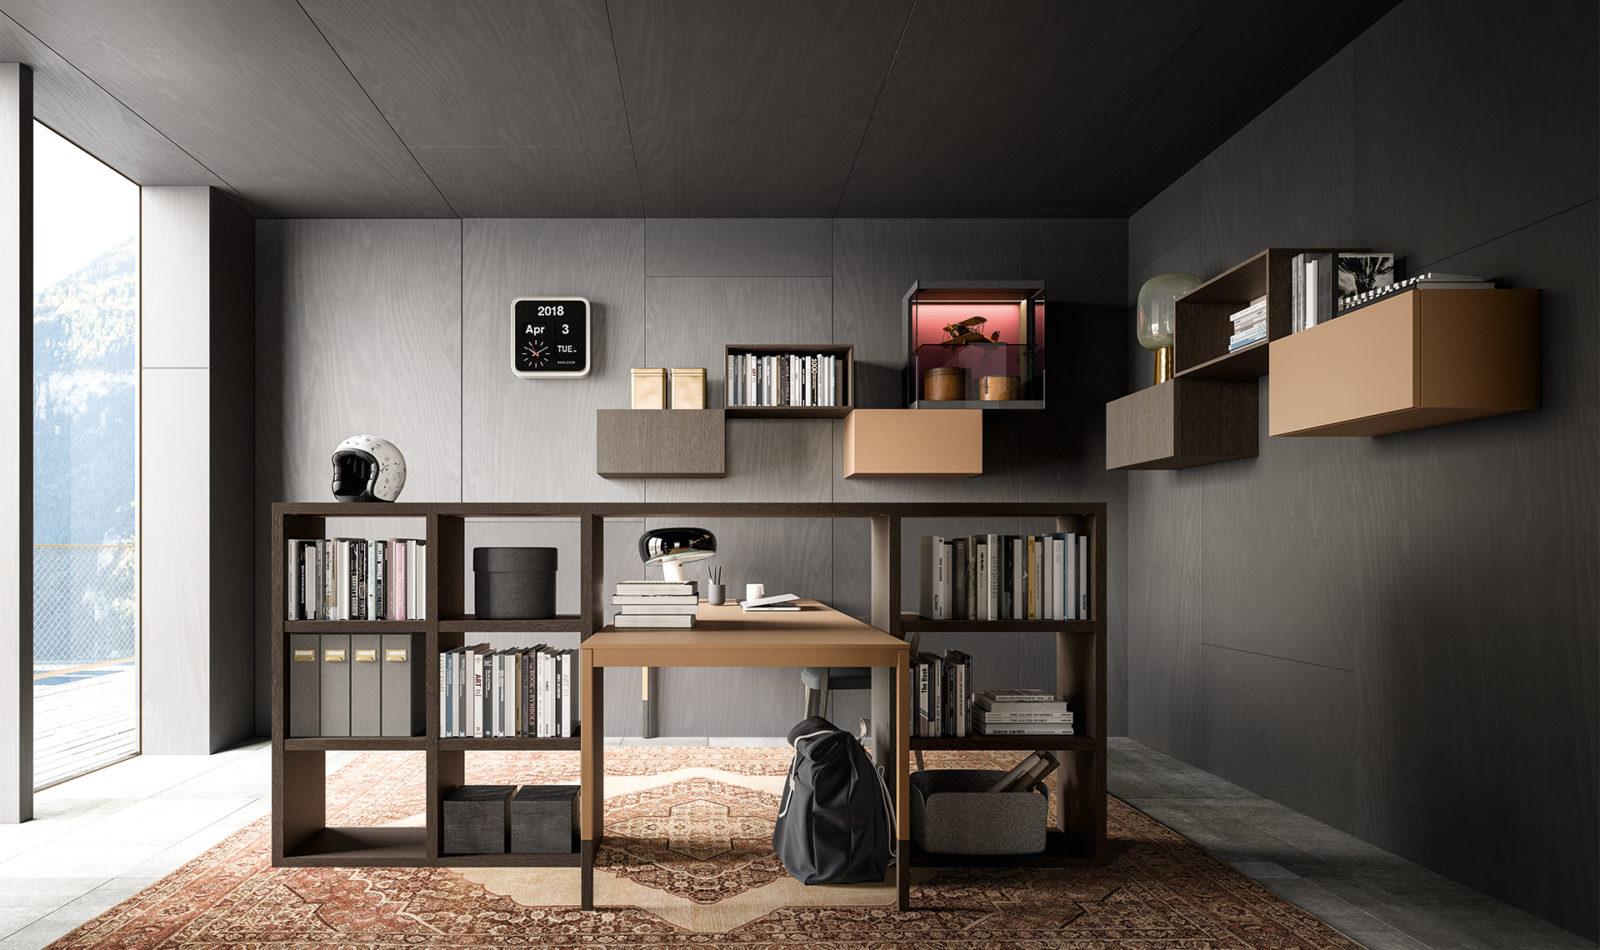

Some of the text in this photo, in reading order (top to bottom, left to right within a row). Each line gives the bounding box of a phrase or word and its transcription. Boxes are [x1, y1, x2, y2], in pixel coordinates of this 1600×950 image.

[537, 305, 565, 316] 2018
[525, 324, 570, 336] Apr 3
[557, 345, 577, 353] TUE.
